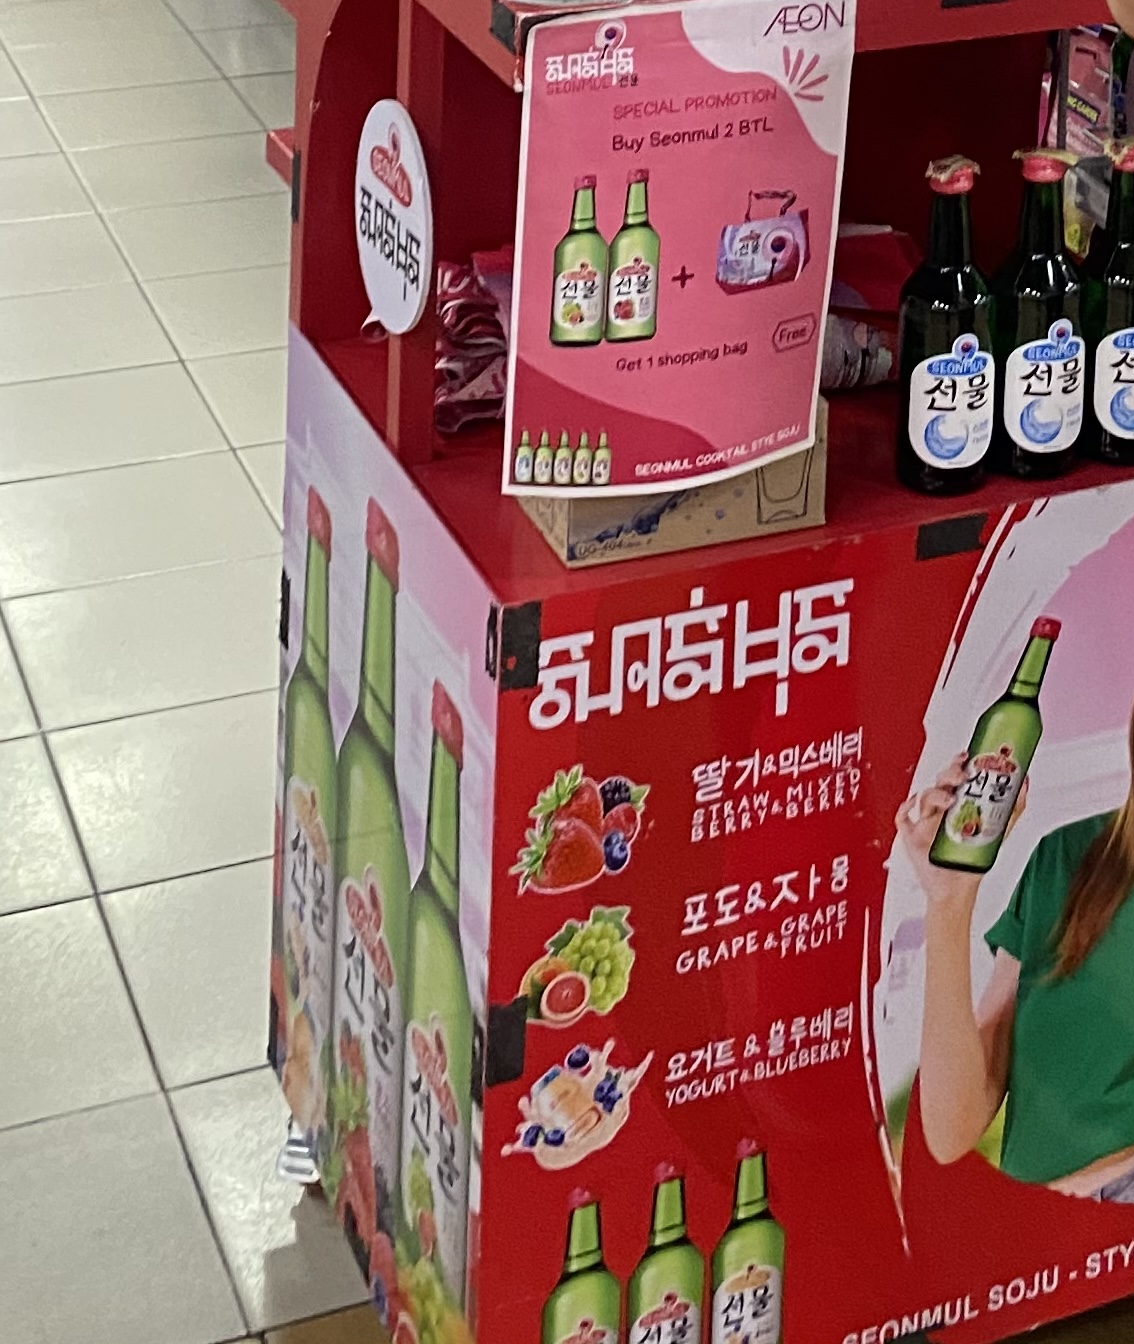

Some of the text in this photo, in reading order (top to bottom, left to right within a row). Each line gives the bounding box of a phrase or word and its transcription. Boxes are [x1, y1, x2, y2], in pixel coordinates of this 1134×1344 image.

[613, 86, 778, 121] SPECIAL PROMOTION
[612, 116, 774, 154] Buy Seonmul 2 BTL
[778, 325, 807, 344] Free
[616, 340, 748, 372] Get 1 shopping bag
[924, 373, 990, 412] 선물
[1020, 356, 1082, 397] 선물
[634, 458, 692, 477] SEONMUL
[690, 808, 768, 843] BERRY
[786, 784, 860, 820] BERRY
[693, 768, 861, 826] STRAW MIXED
[675, 930, 759, 974] GRAPE
[780, 899, 848, 936] GRAPE
[780, 920, 847, 959] FRUIT
[664, 1037, 736, 1083] 요거트
[986, 1264, 1060, 1312] SOJU
